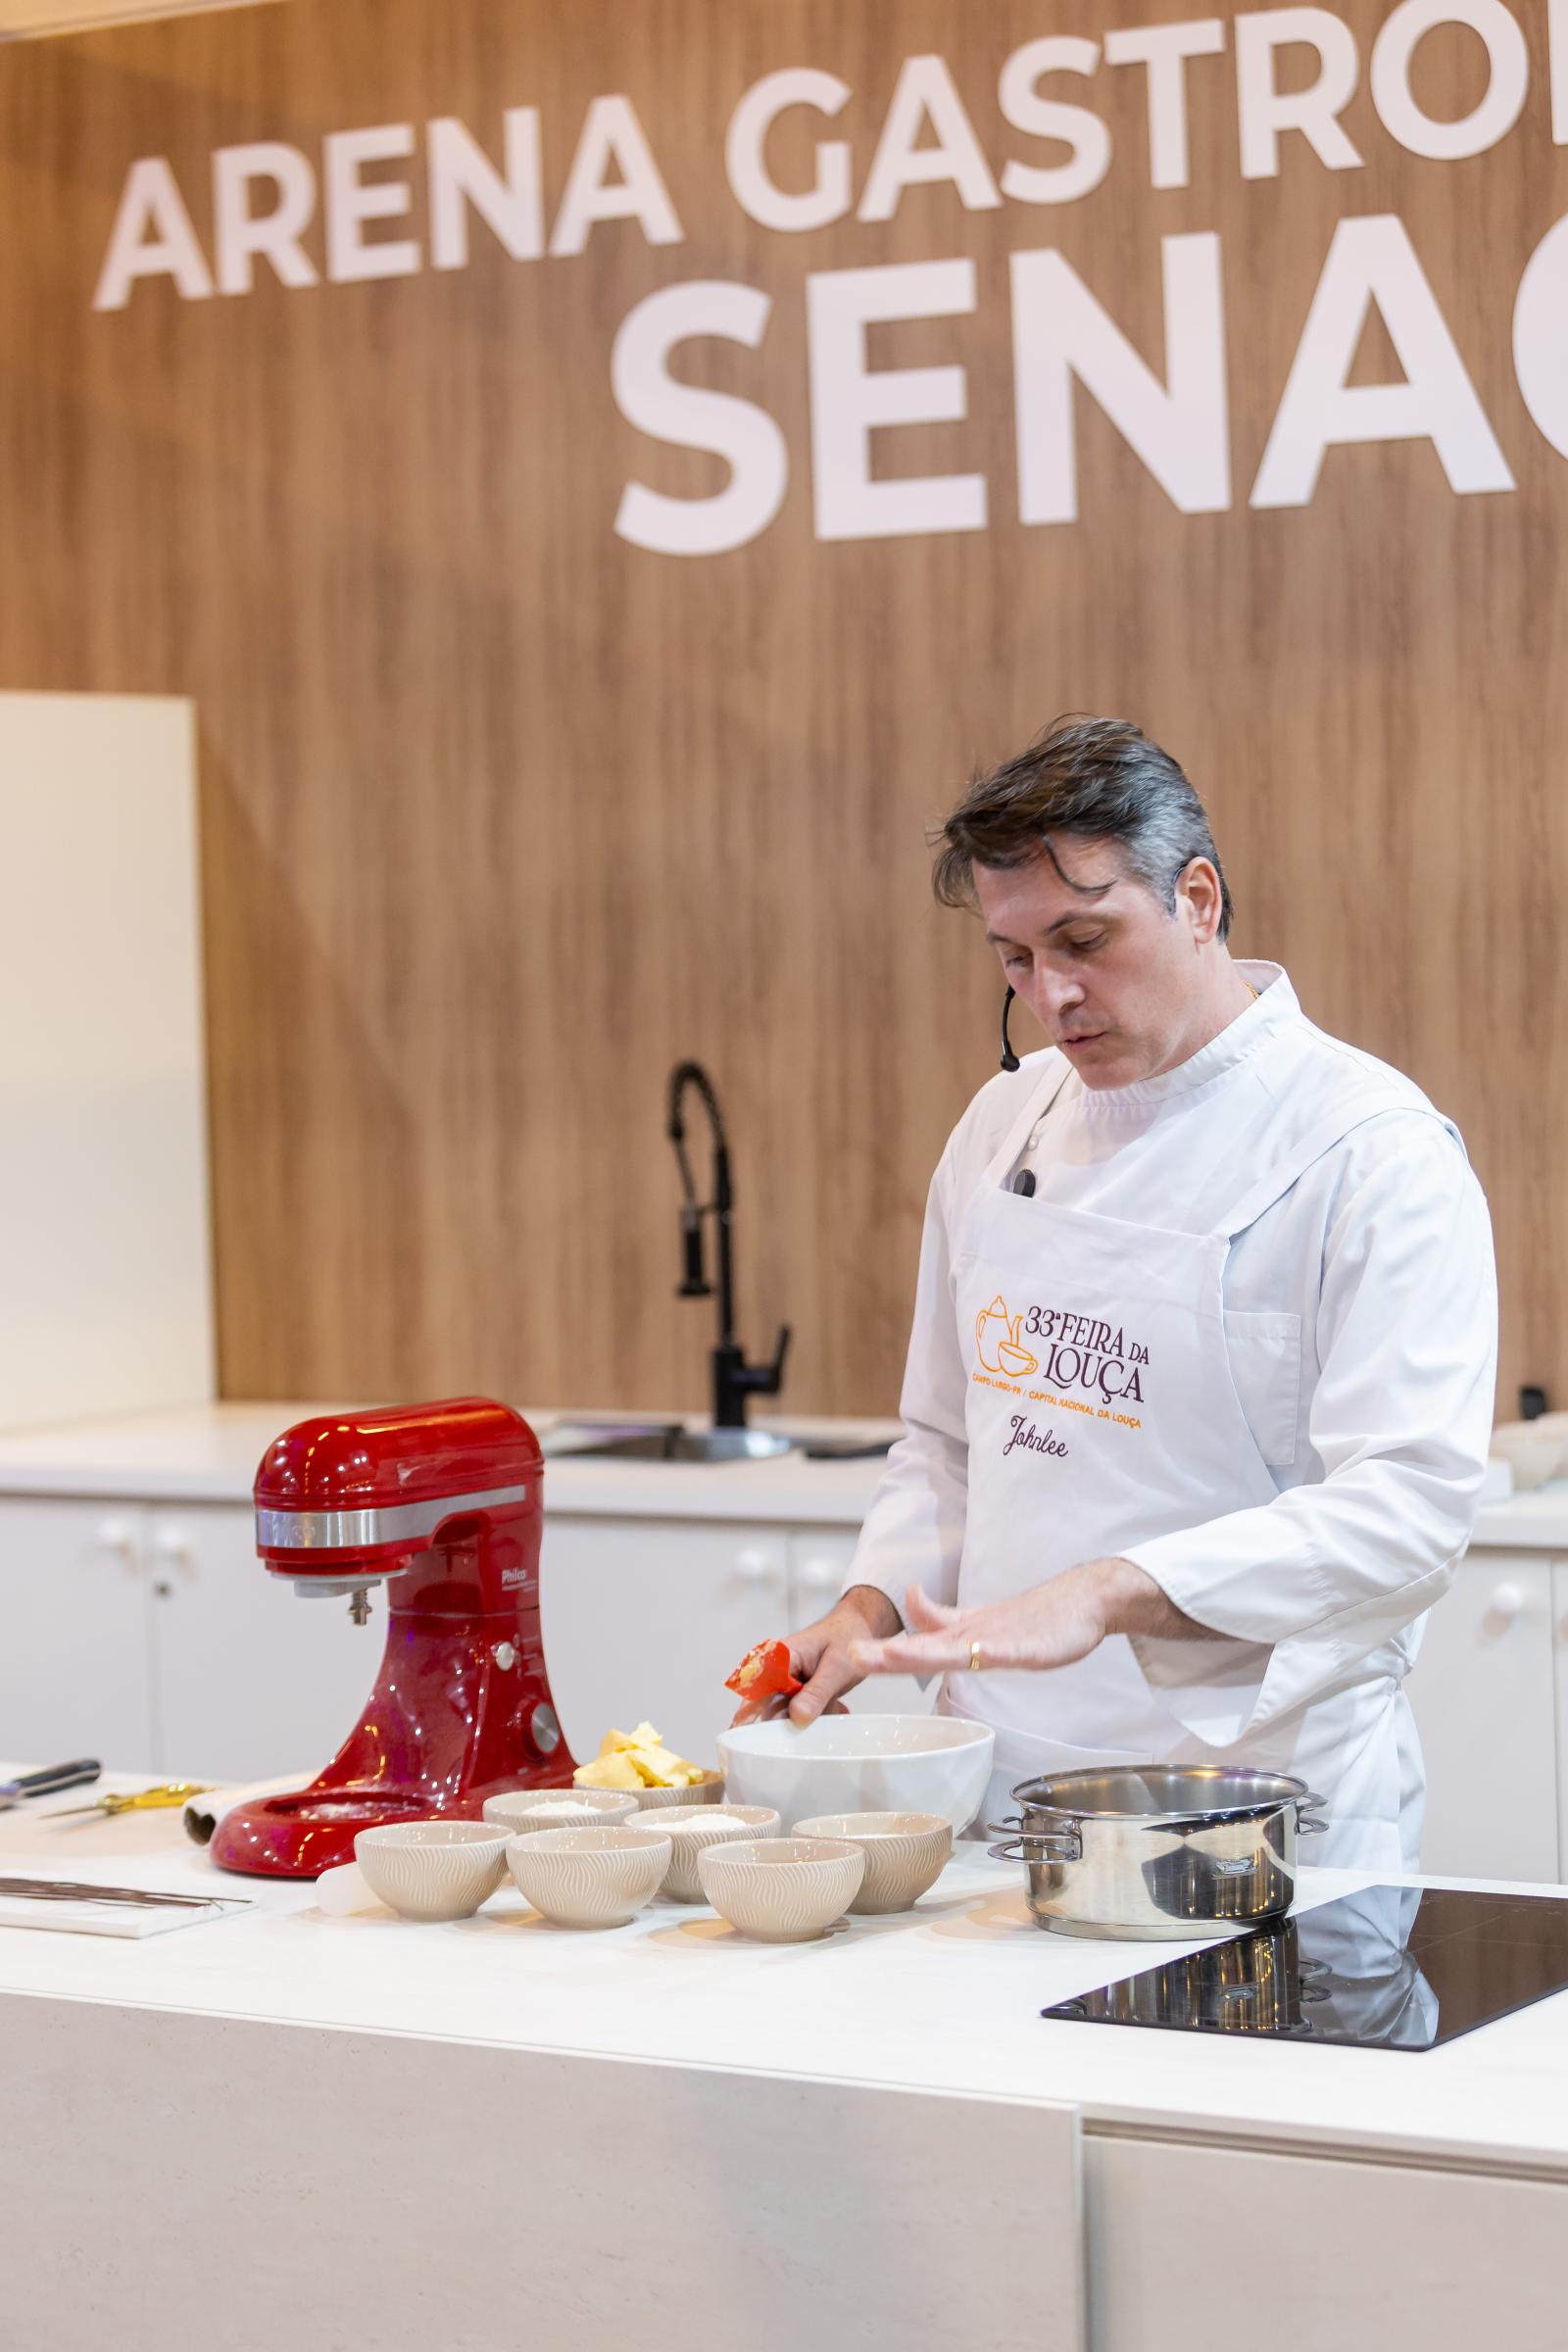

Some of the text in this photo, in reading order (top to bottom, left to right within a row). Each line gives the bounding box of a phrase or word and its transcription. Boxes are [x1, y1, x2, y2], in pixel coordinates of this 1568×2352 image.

[93, 0, 1568, 311] ARENA GASTRO
[610, 213, 1568, 557] SENA
[1057, 1312, 1124, 1357] FEIRA
[1128, 1342, 1150, 1365] DA
[1043, 1343, 1145, 1404] LOUÇA
[1003, 1414, 1069, 1457] Johnlee
[1028, 1390, 1057, 1405] CAPITAL
[1058, 1398, 1095, 1416] NACIONAL
[1097, 1409, 1110, 1420] DA
[1112, 1414, 1142, 1429] LOUÇA
